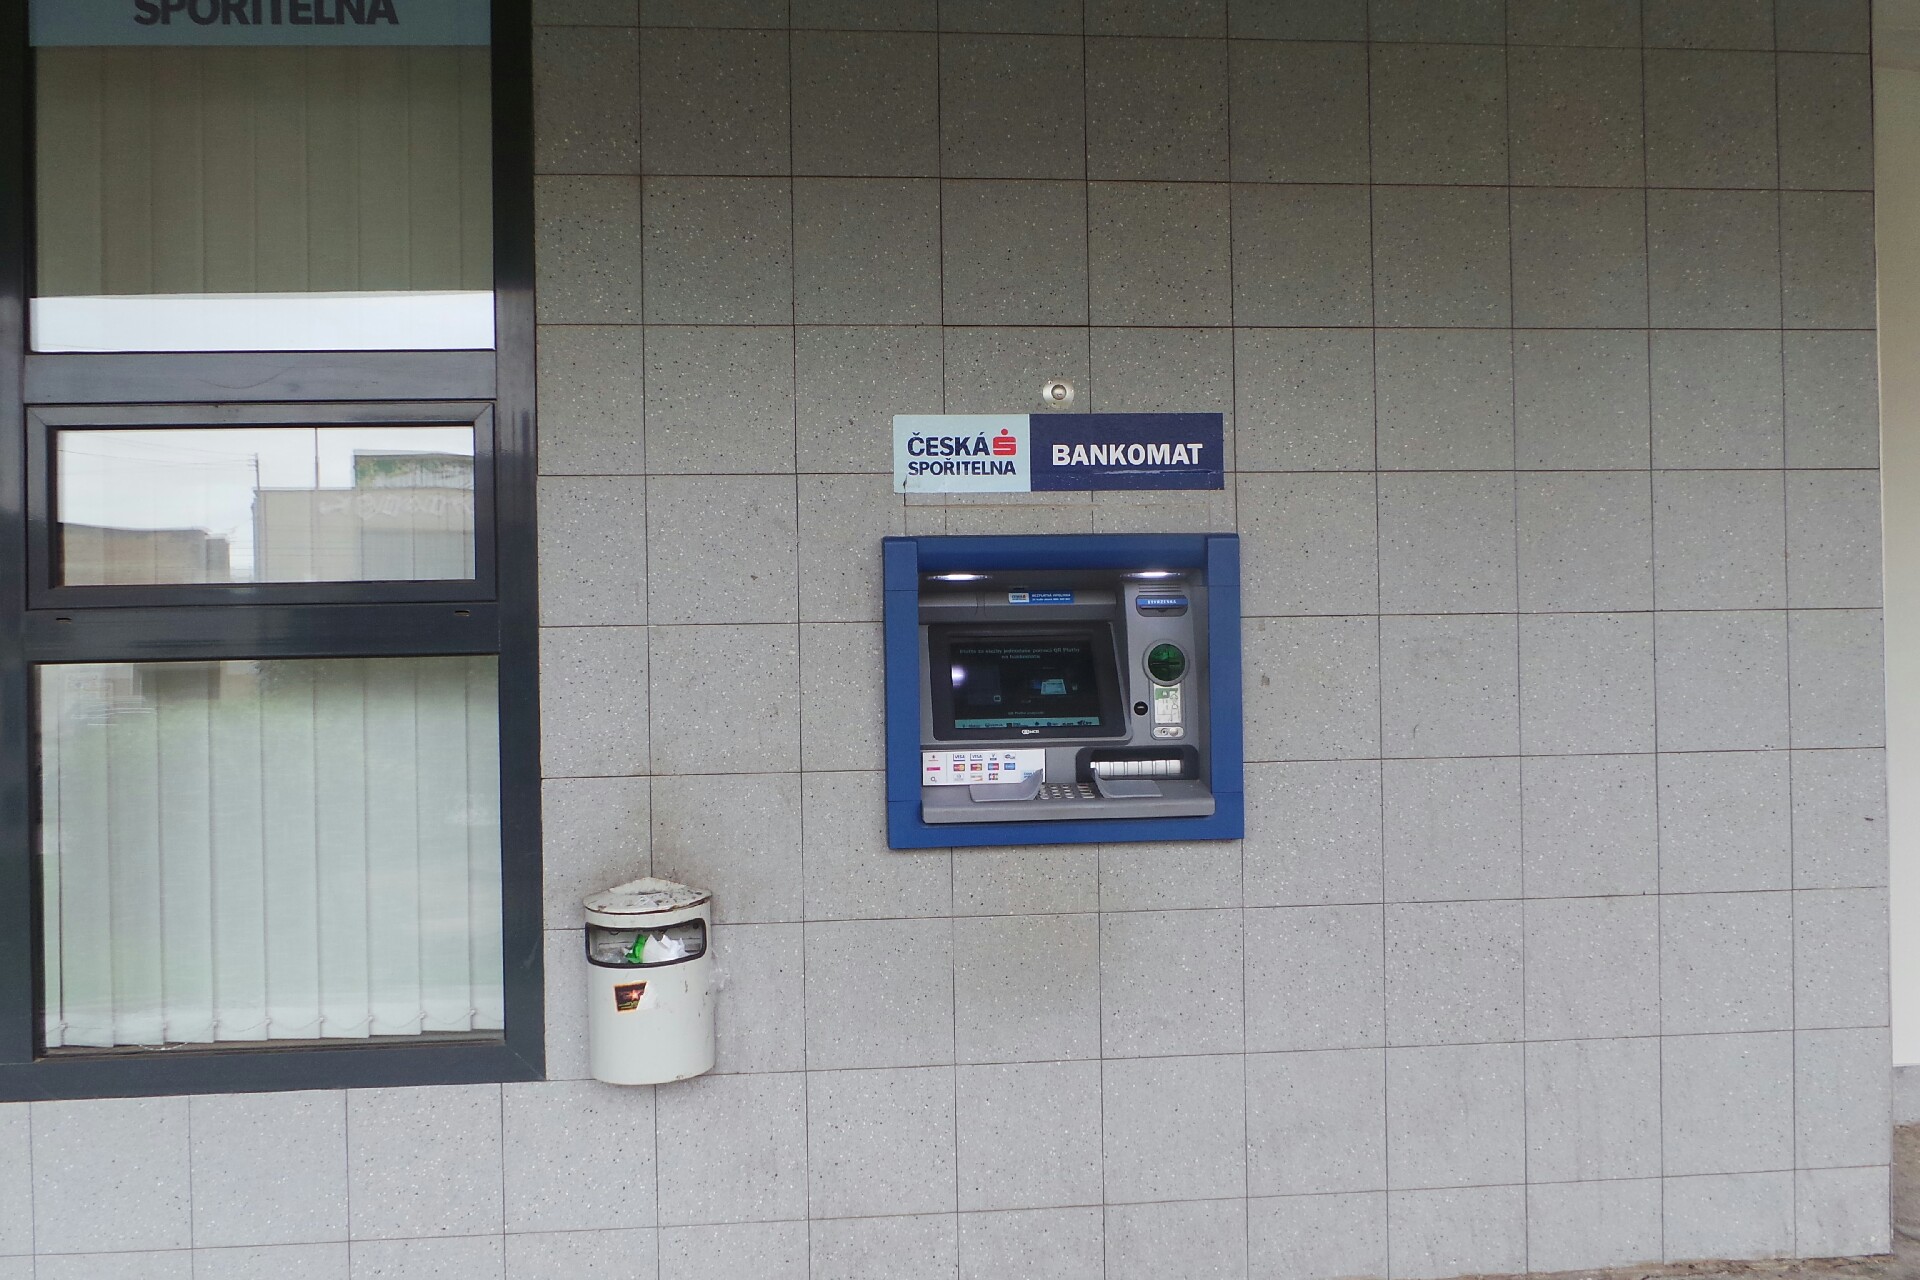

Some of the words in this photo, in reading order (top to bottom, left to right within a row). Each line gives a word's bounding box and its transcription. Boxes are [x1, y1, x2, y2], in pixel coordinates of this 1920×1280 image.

[907, 431, 990, 456] ČESKÁ
[1052, 443, 1203, 466] BANKOMAT
[908, 458, 1016, 476] SPOŘITELNA
